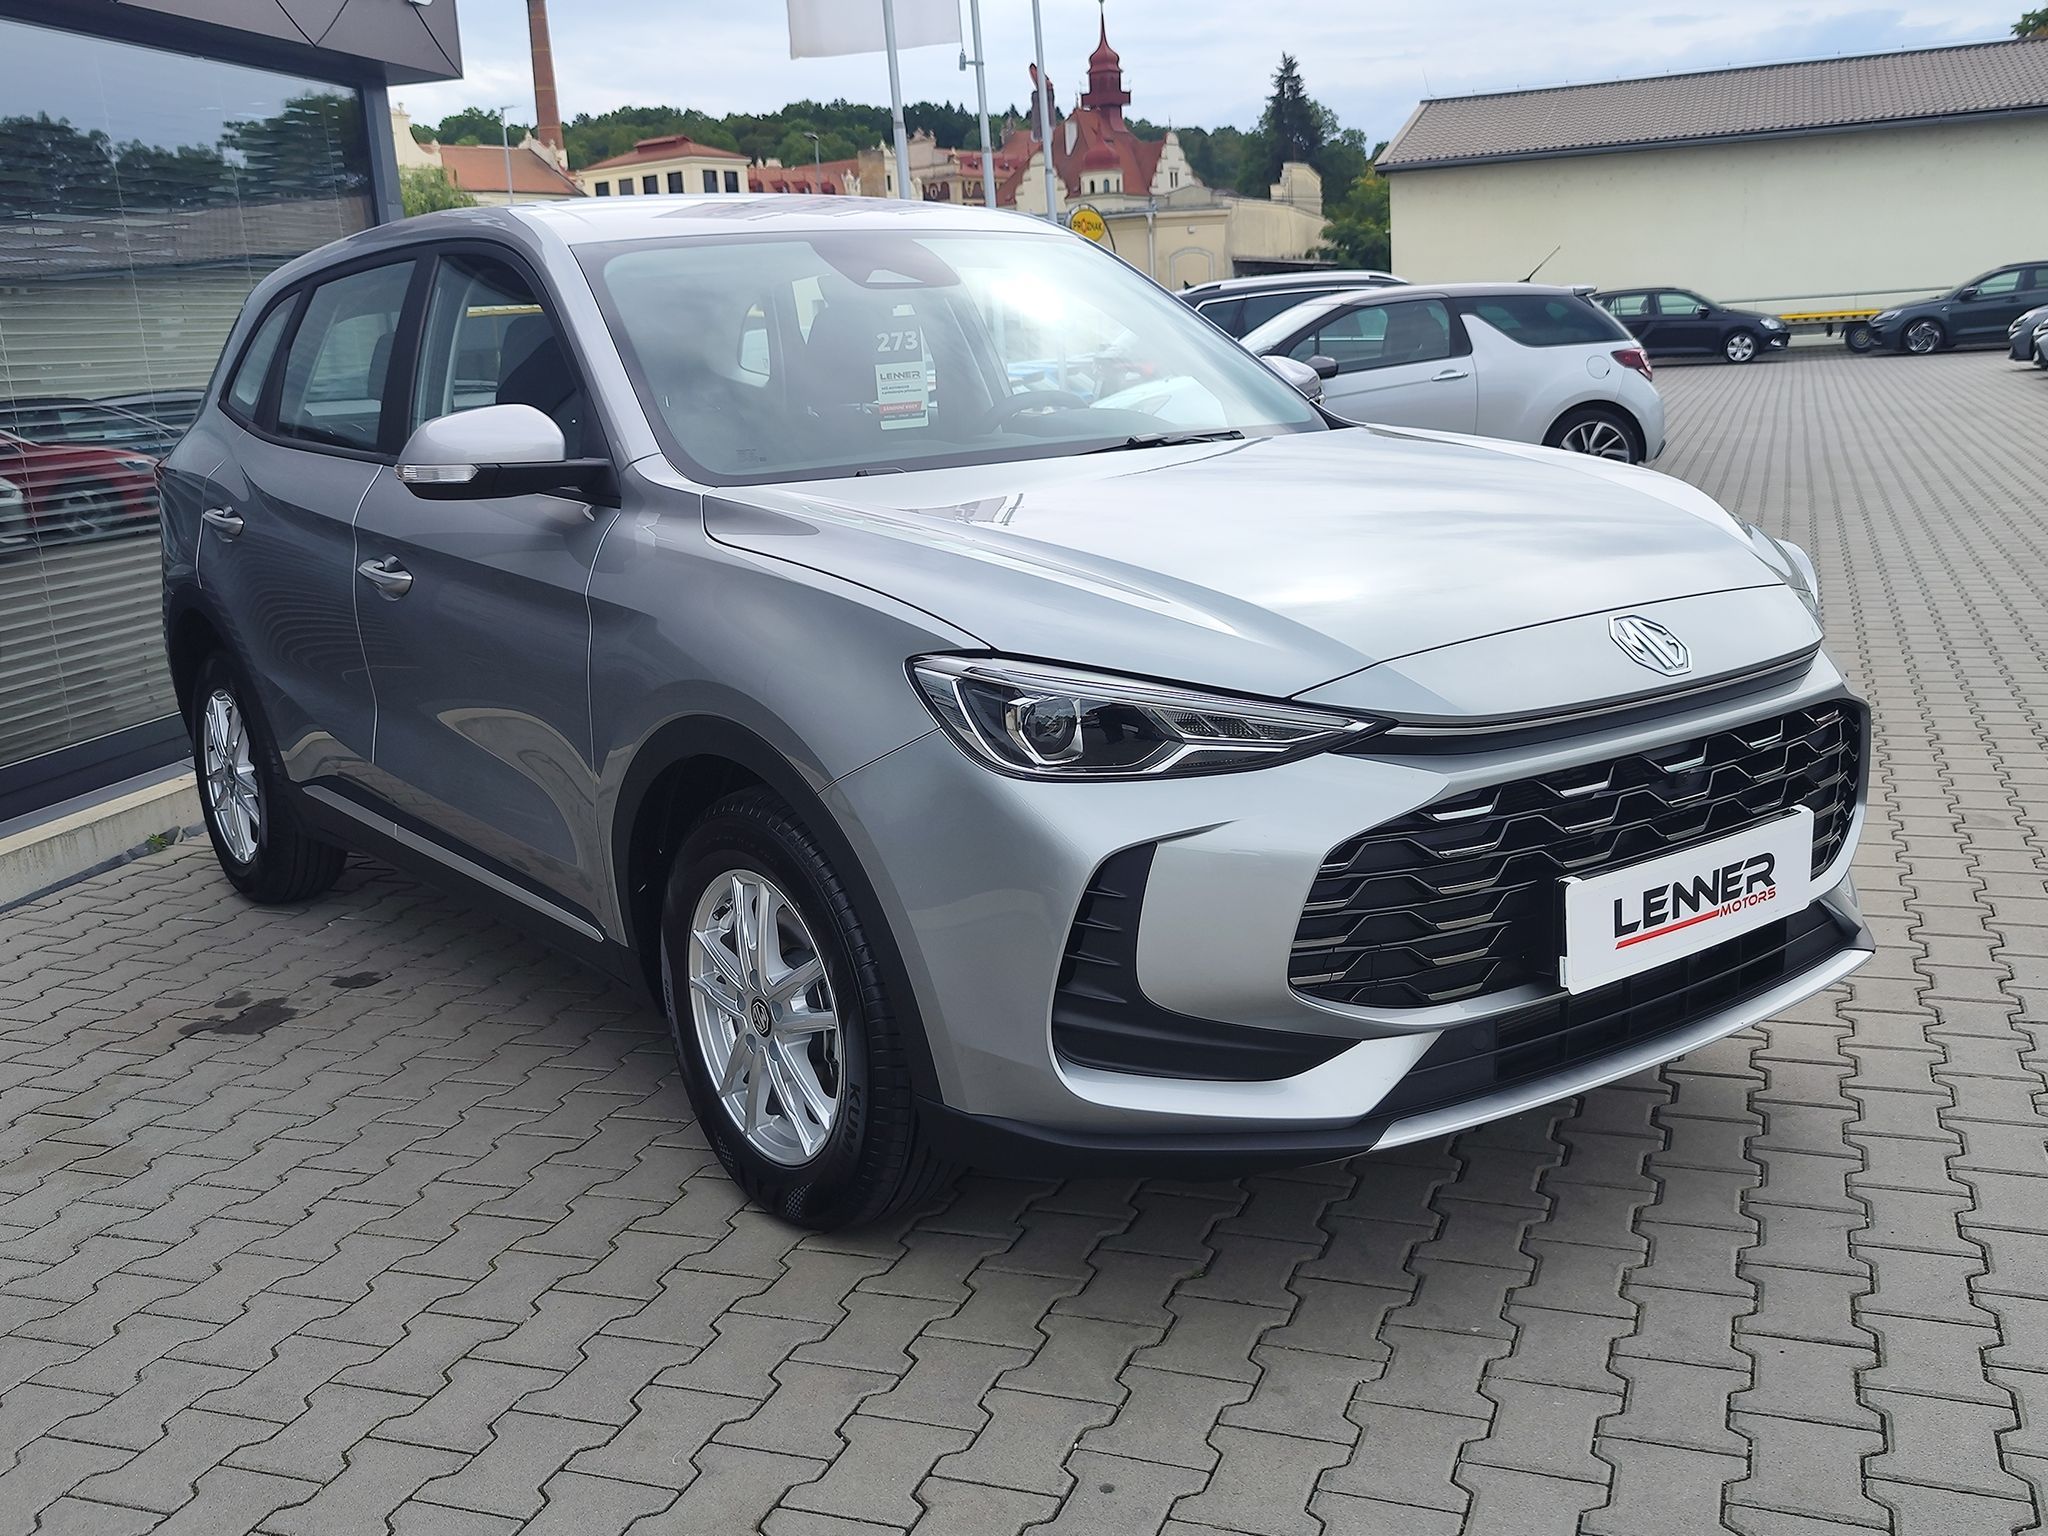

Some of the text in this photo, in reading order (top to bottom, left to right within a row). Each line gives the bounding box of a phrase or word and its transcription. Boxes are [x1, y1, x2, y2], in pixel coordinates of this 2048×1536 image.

[876, 331, 918, 353] 273
[880, 371, 921, 380] LENNER
[1615, 617, 1687, 672] MG
[1613, 852, 1776, 939] LENNER
[1718, 887, 1777, 917] MOTORS
